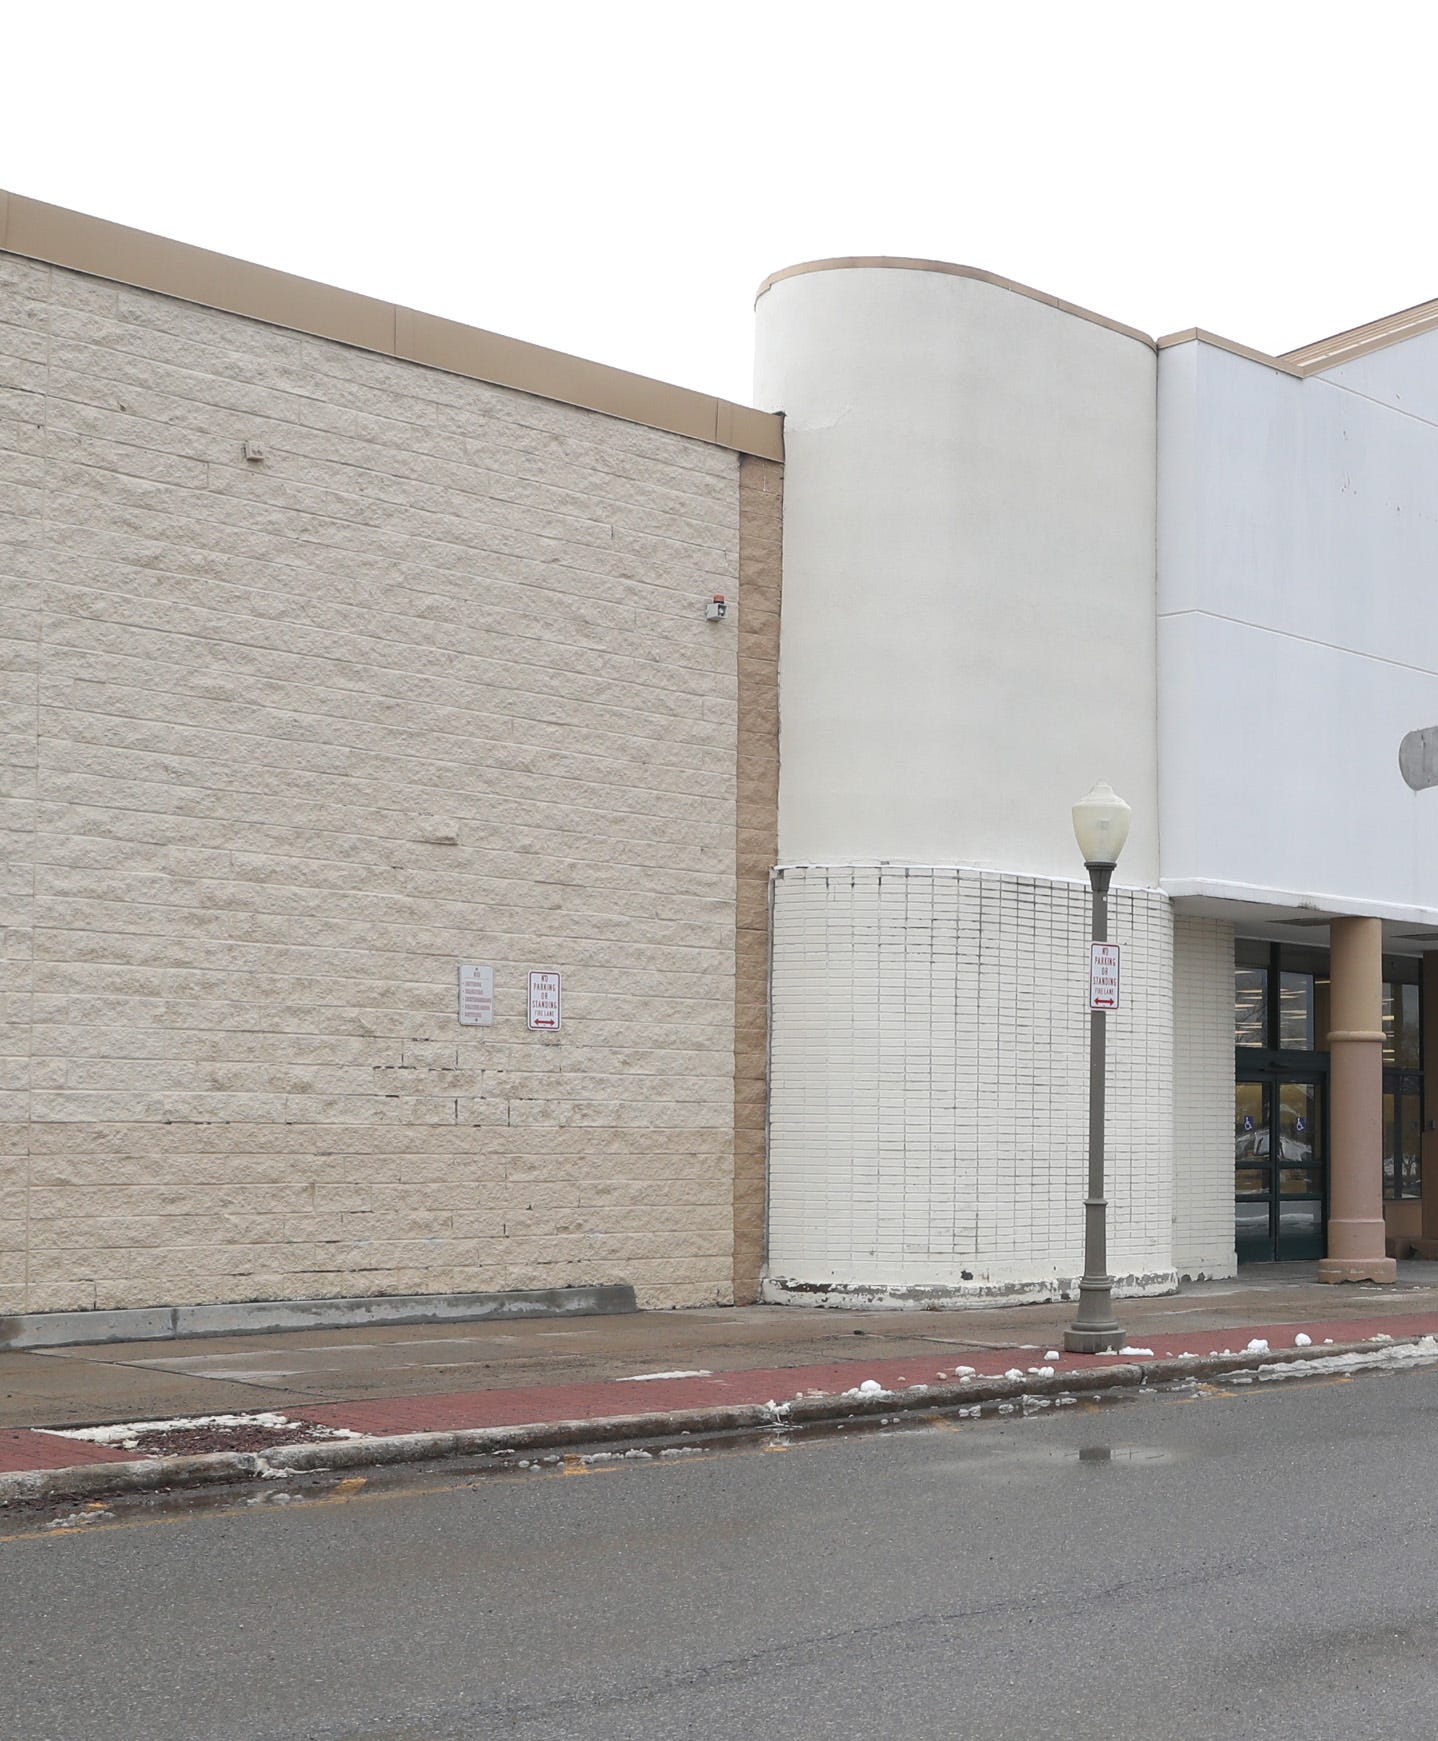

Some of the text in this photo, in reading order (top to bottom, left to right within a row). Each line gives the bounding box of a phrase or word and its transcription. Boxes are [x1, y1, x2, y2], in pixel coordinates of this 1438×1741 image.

[1095, 956, 1116, 966] PARKING
[1093, 976, 1117, 987] STANDING
[533, 983, 556, 992] PARKING
[541, 992, 548, 1000] OR
[532, 1001, 557, 1009] STANDING
